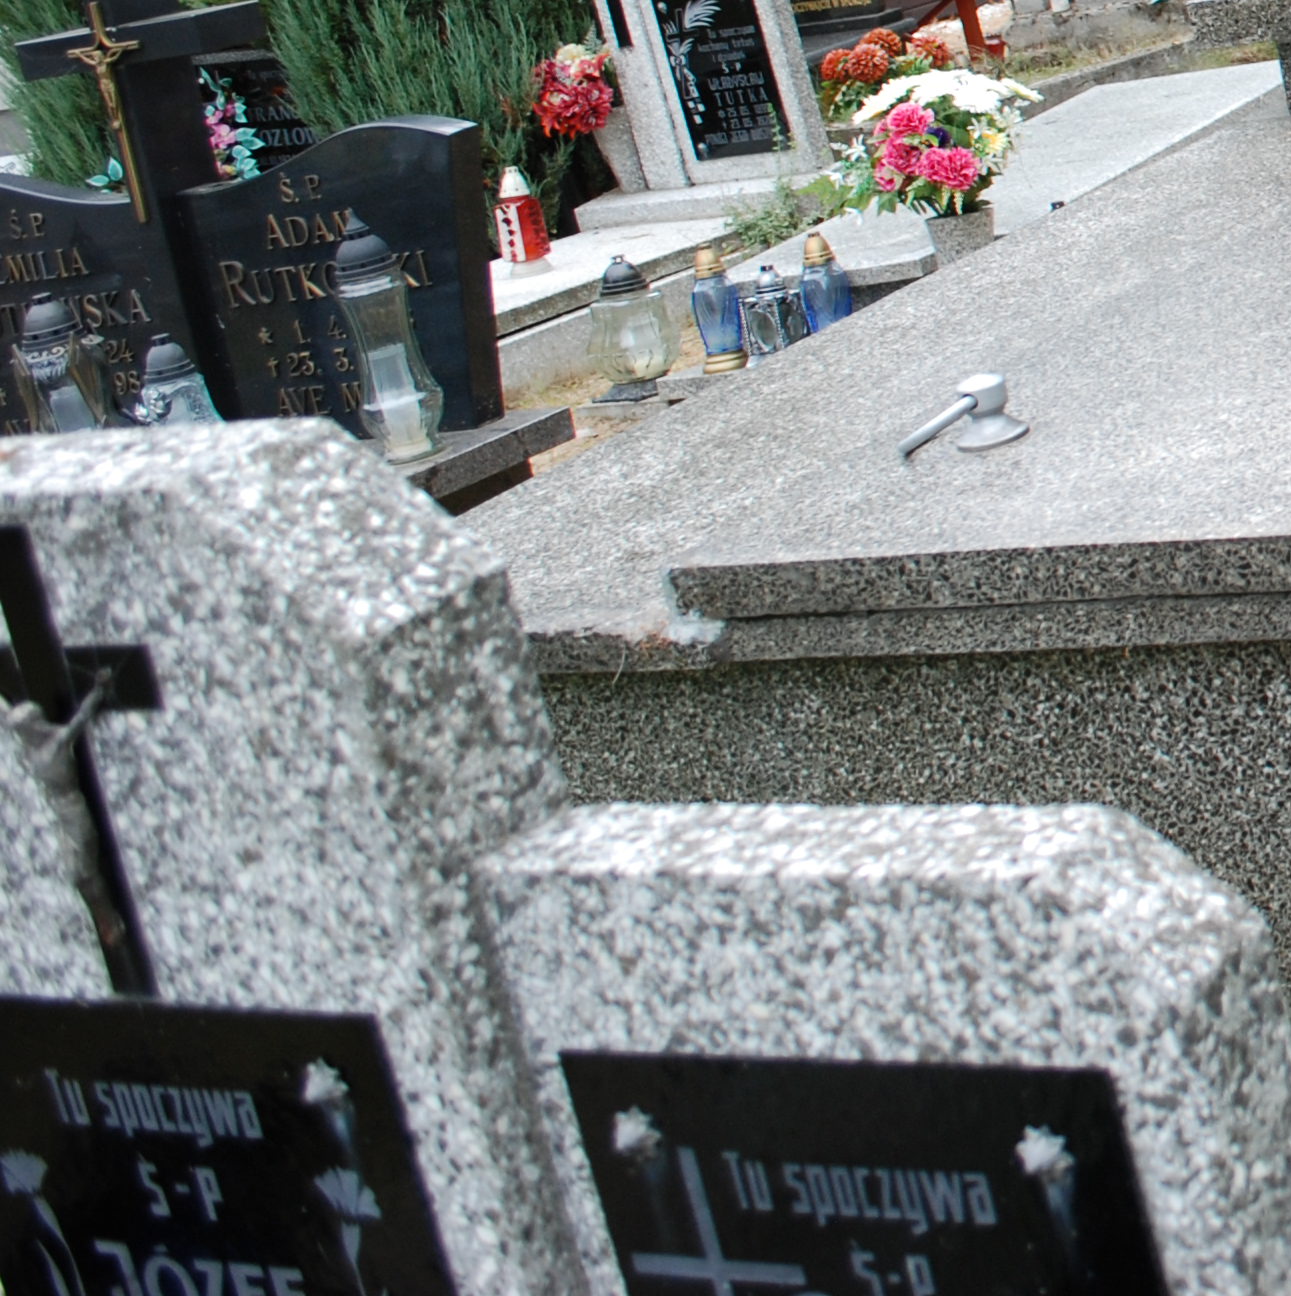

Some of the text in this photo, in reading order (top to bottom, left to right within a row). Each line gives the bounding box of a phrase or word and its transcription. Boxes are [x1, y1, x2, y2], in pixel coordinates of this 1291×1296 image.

[278, 384, 332, 418] AVE
[43, 1068, 264, 1148] Tu spoczywa
[722, 1150, 998, 1237] Tu spoczywa
